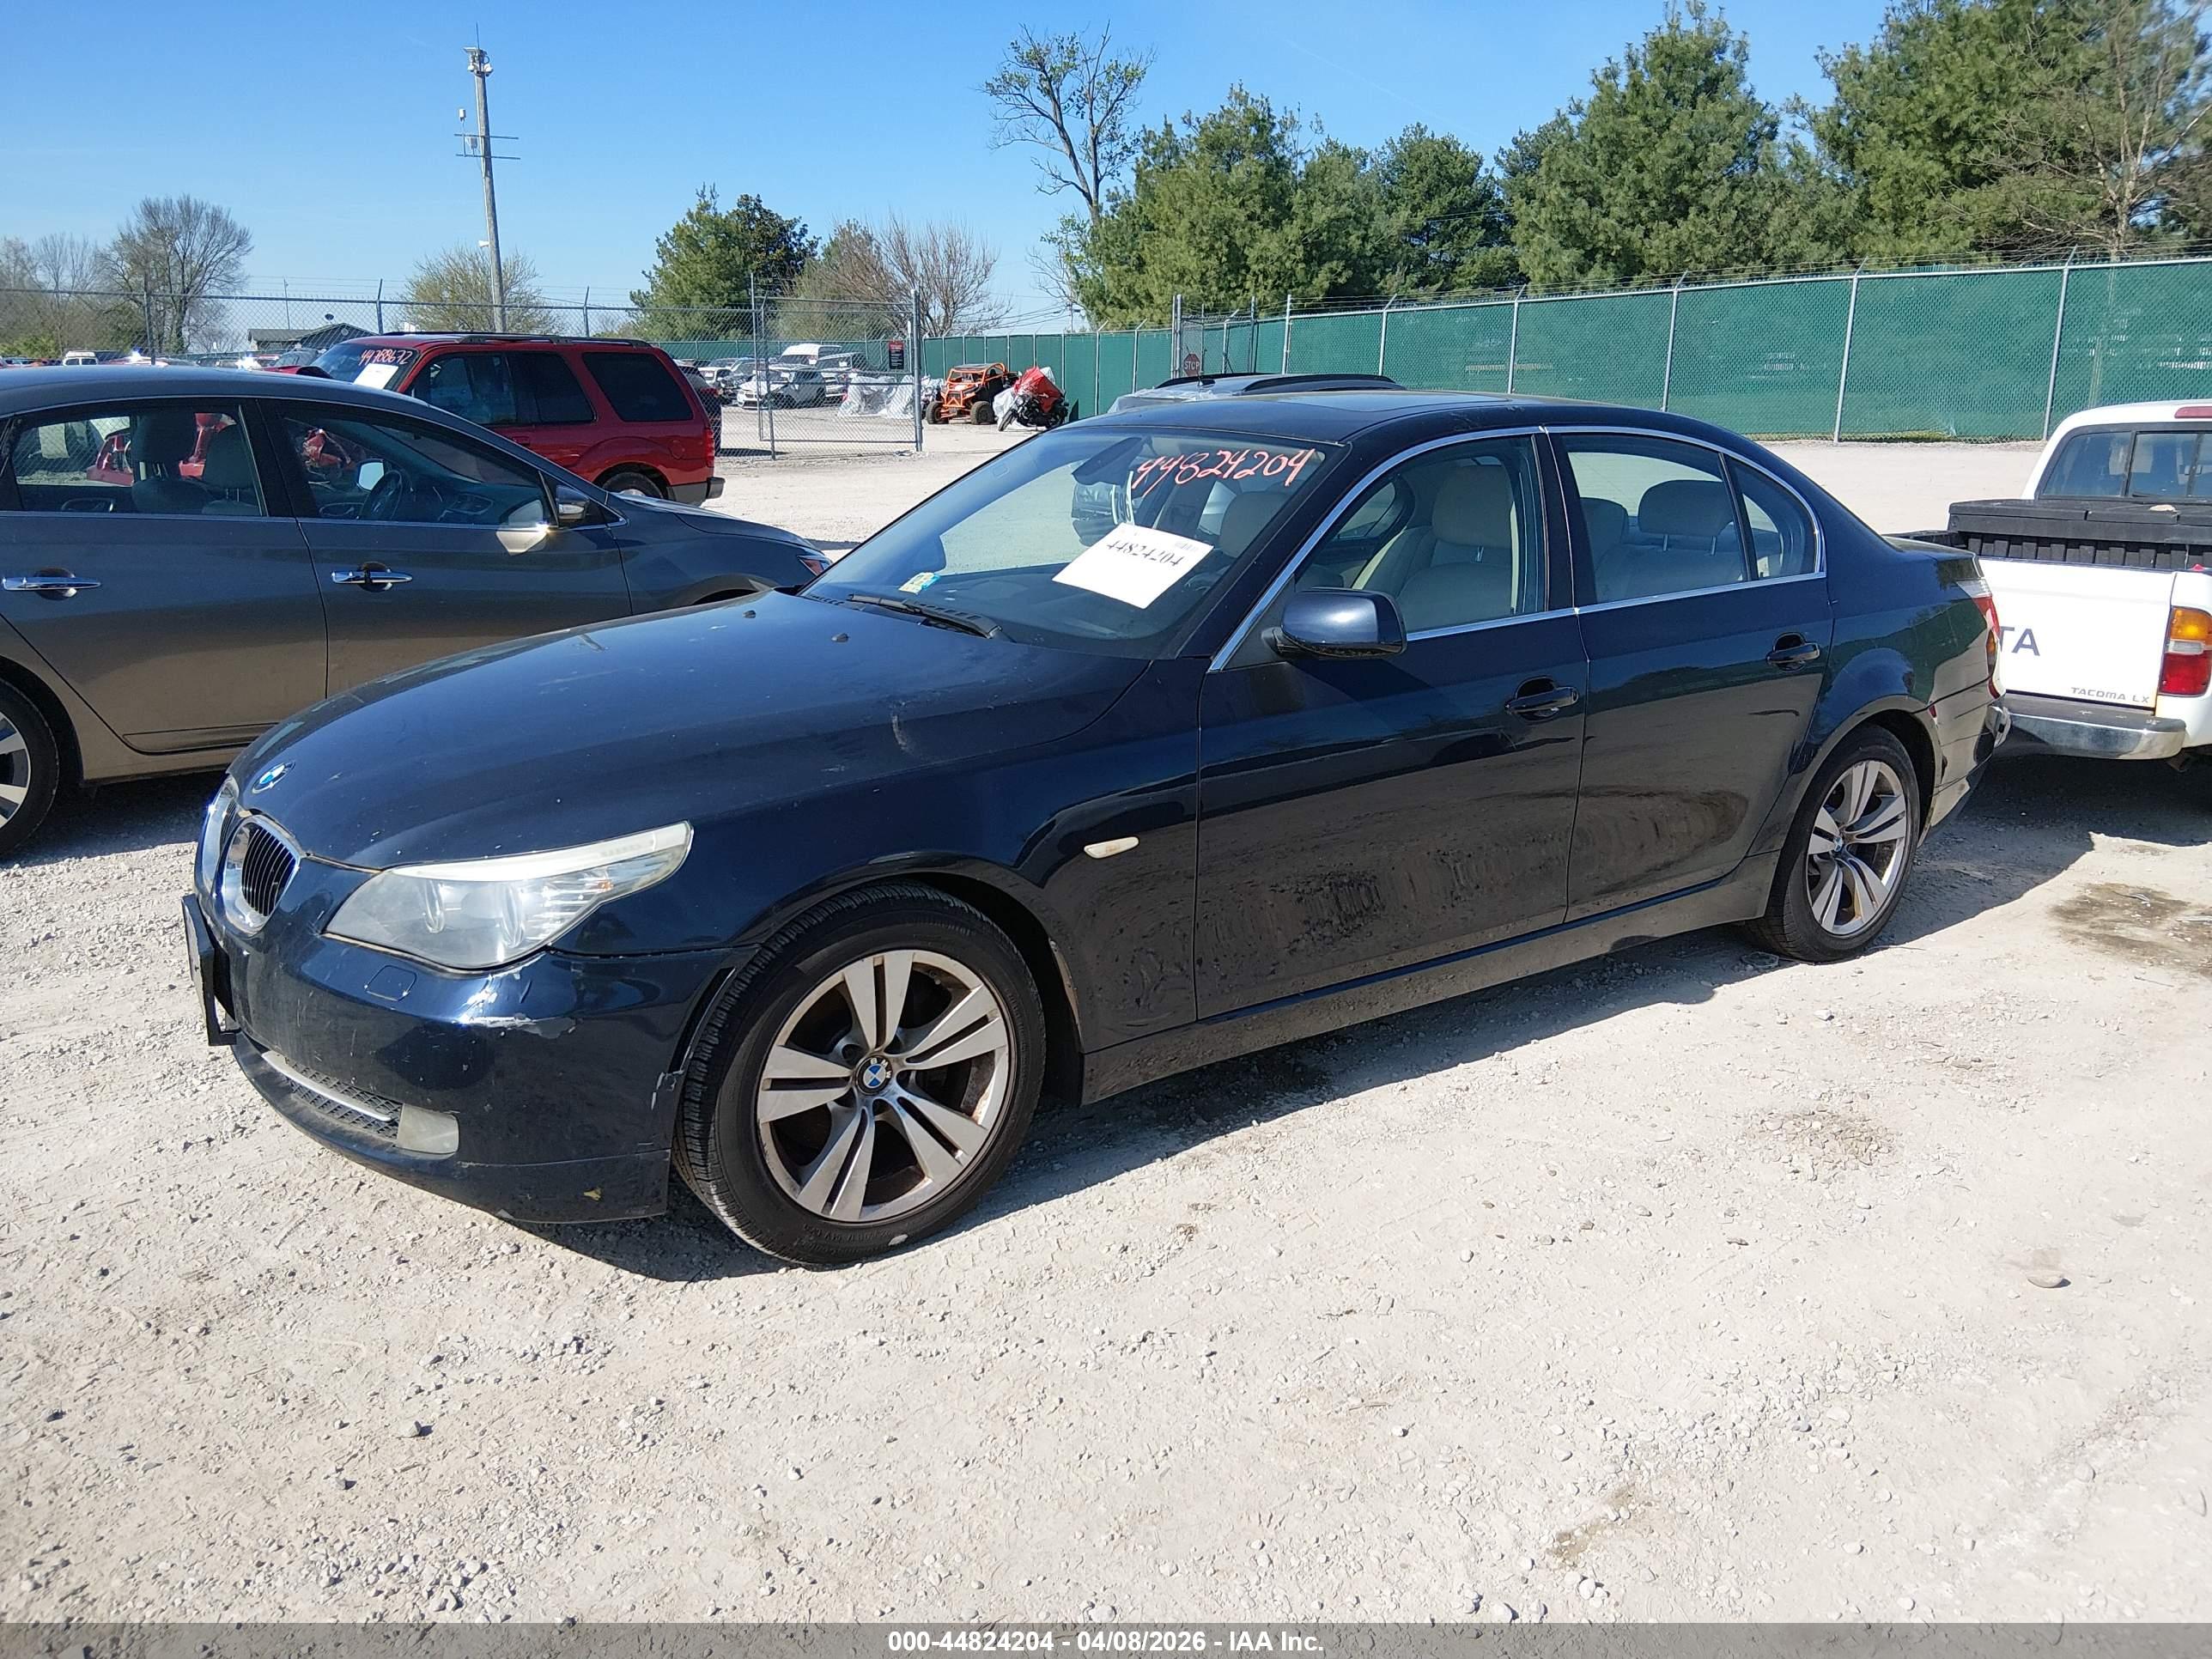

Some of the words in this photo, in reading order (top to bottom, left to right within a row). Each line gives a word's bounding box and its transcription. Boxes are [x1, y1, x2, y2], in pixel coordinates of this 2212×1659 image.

[1184, 361, 1200, 370] STOP
[1131, 447, 1316, 498] 44824204
[2071, 687, 2126, 700] TACOMA
[2132, 695, 2149, 703] LX
